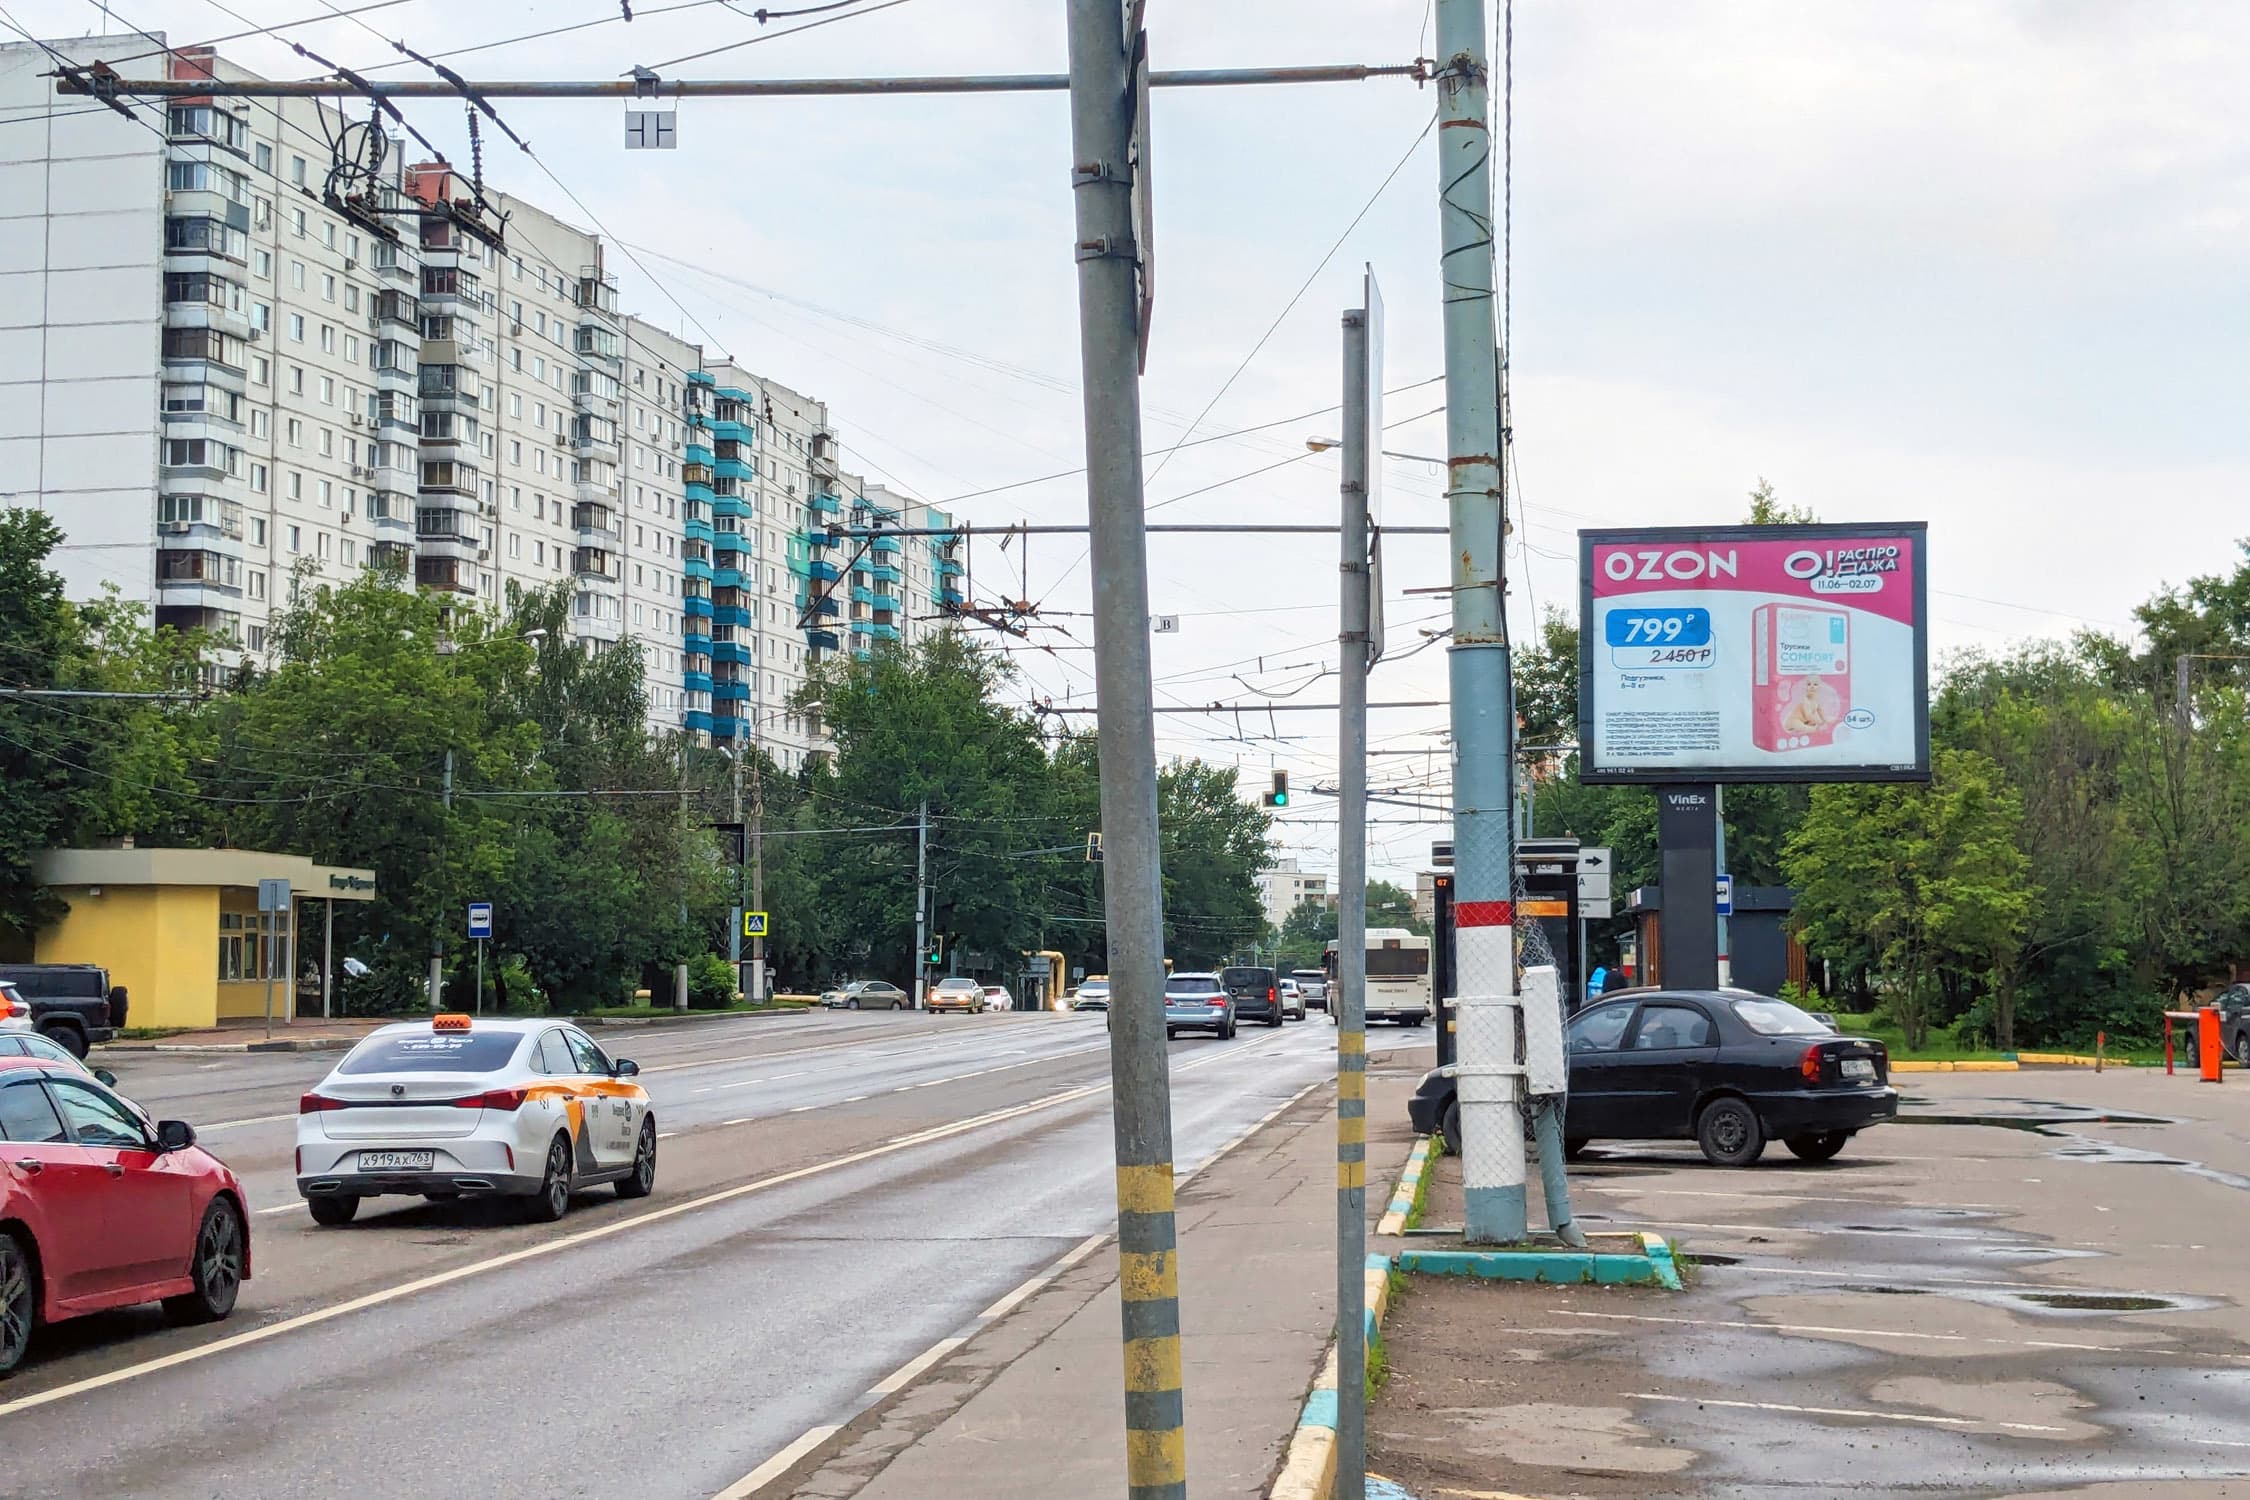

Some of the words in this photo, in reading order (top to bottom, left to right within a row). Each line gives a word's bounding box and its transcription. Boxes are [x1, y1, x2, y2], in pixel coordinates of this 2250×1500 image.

[1837, 546, 1898, 562] РАСПРО
[1604, 550, 1737, 581] OZON
[1836, 559, 1896, 576] ДАЖА
[1624, 617, 1683, 643] 799
[1668, 794, 1706, 805] VinEx
